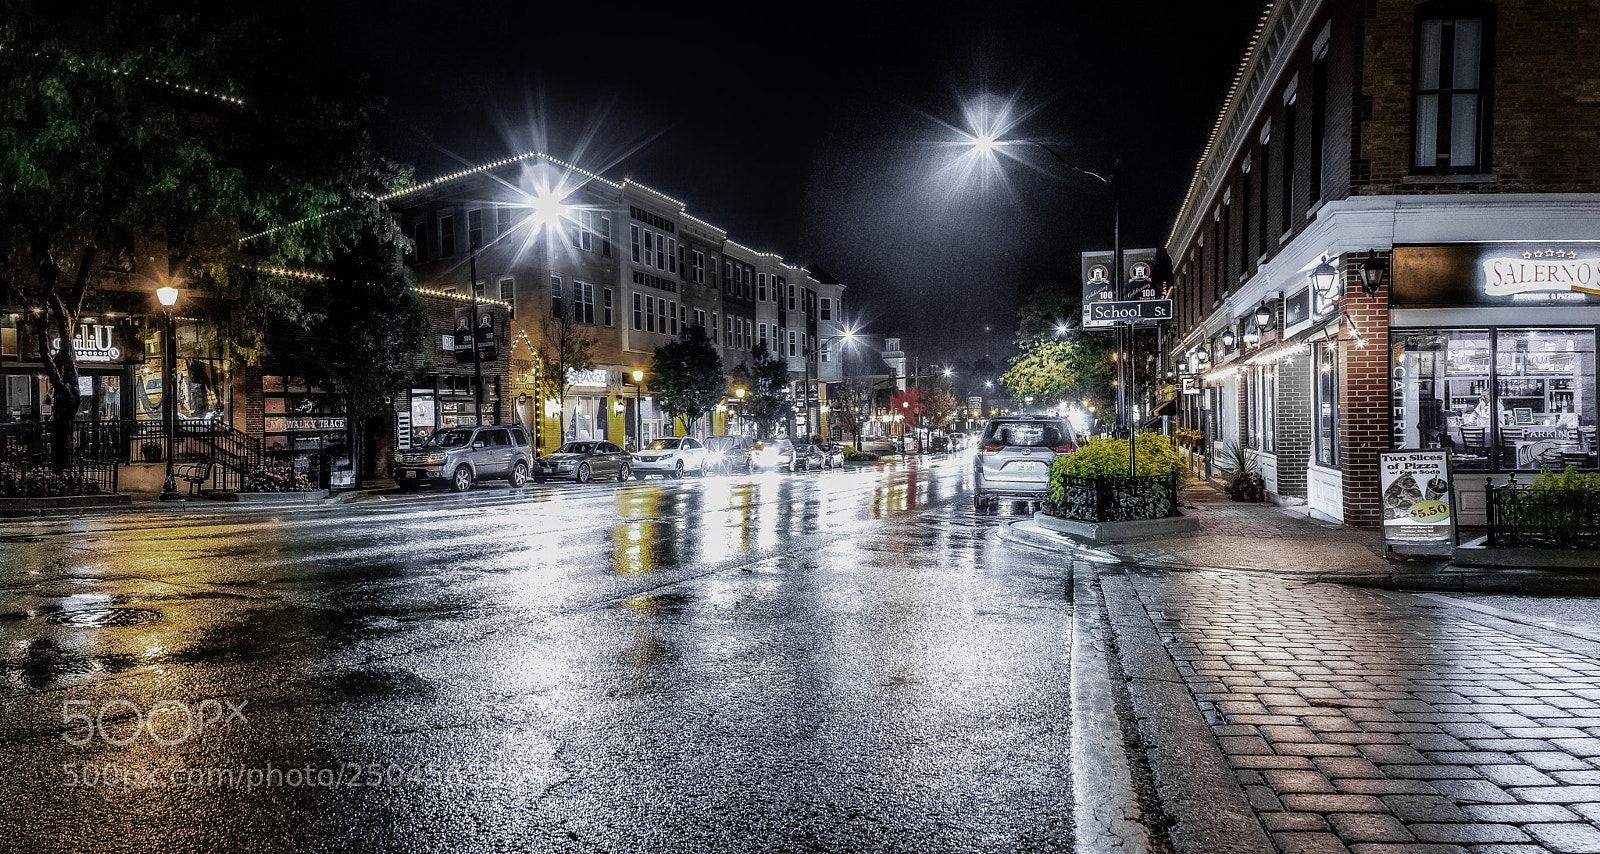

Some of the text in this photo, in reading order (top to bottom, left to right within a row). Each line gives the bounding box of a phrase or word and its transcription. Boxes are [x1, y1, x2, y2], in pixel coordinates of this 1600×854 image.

[1493, 260, 1600, 287] SALERNO
[1099, 291, 1113, 300] 100
[1142, 289, 1155, 298] 100
[1095, 304, 1142, 319] School
[1154, 306, 1166, 316] St
[318, 419, 345, 428] TRACE
[1521, 428, 1573, 438] PARKING
[1410, 504, 1447, 518] $5.50
